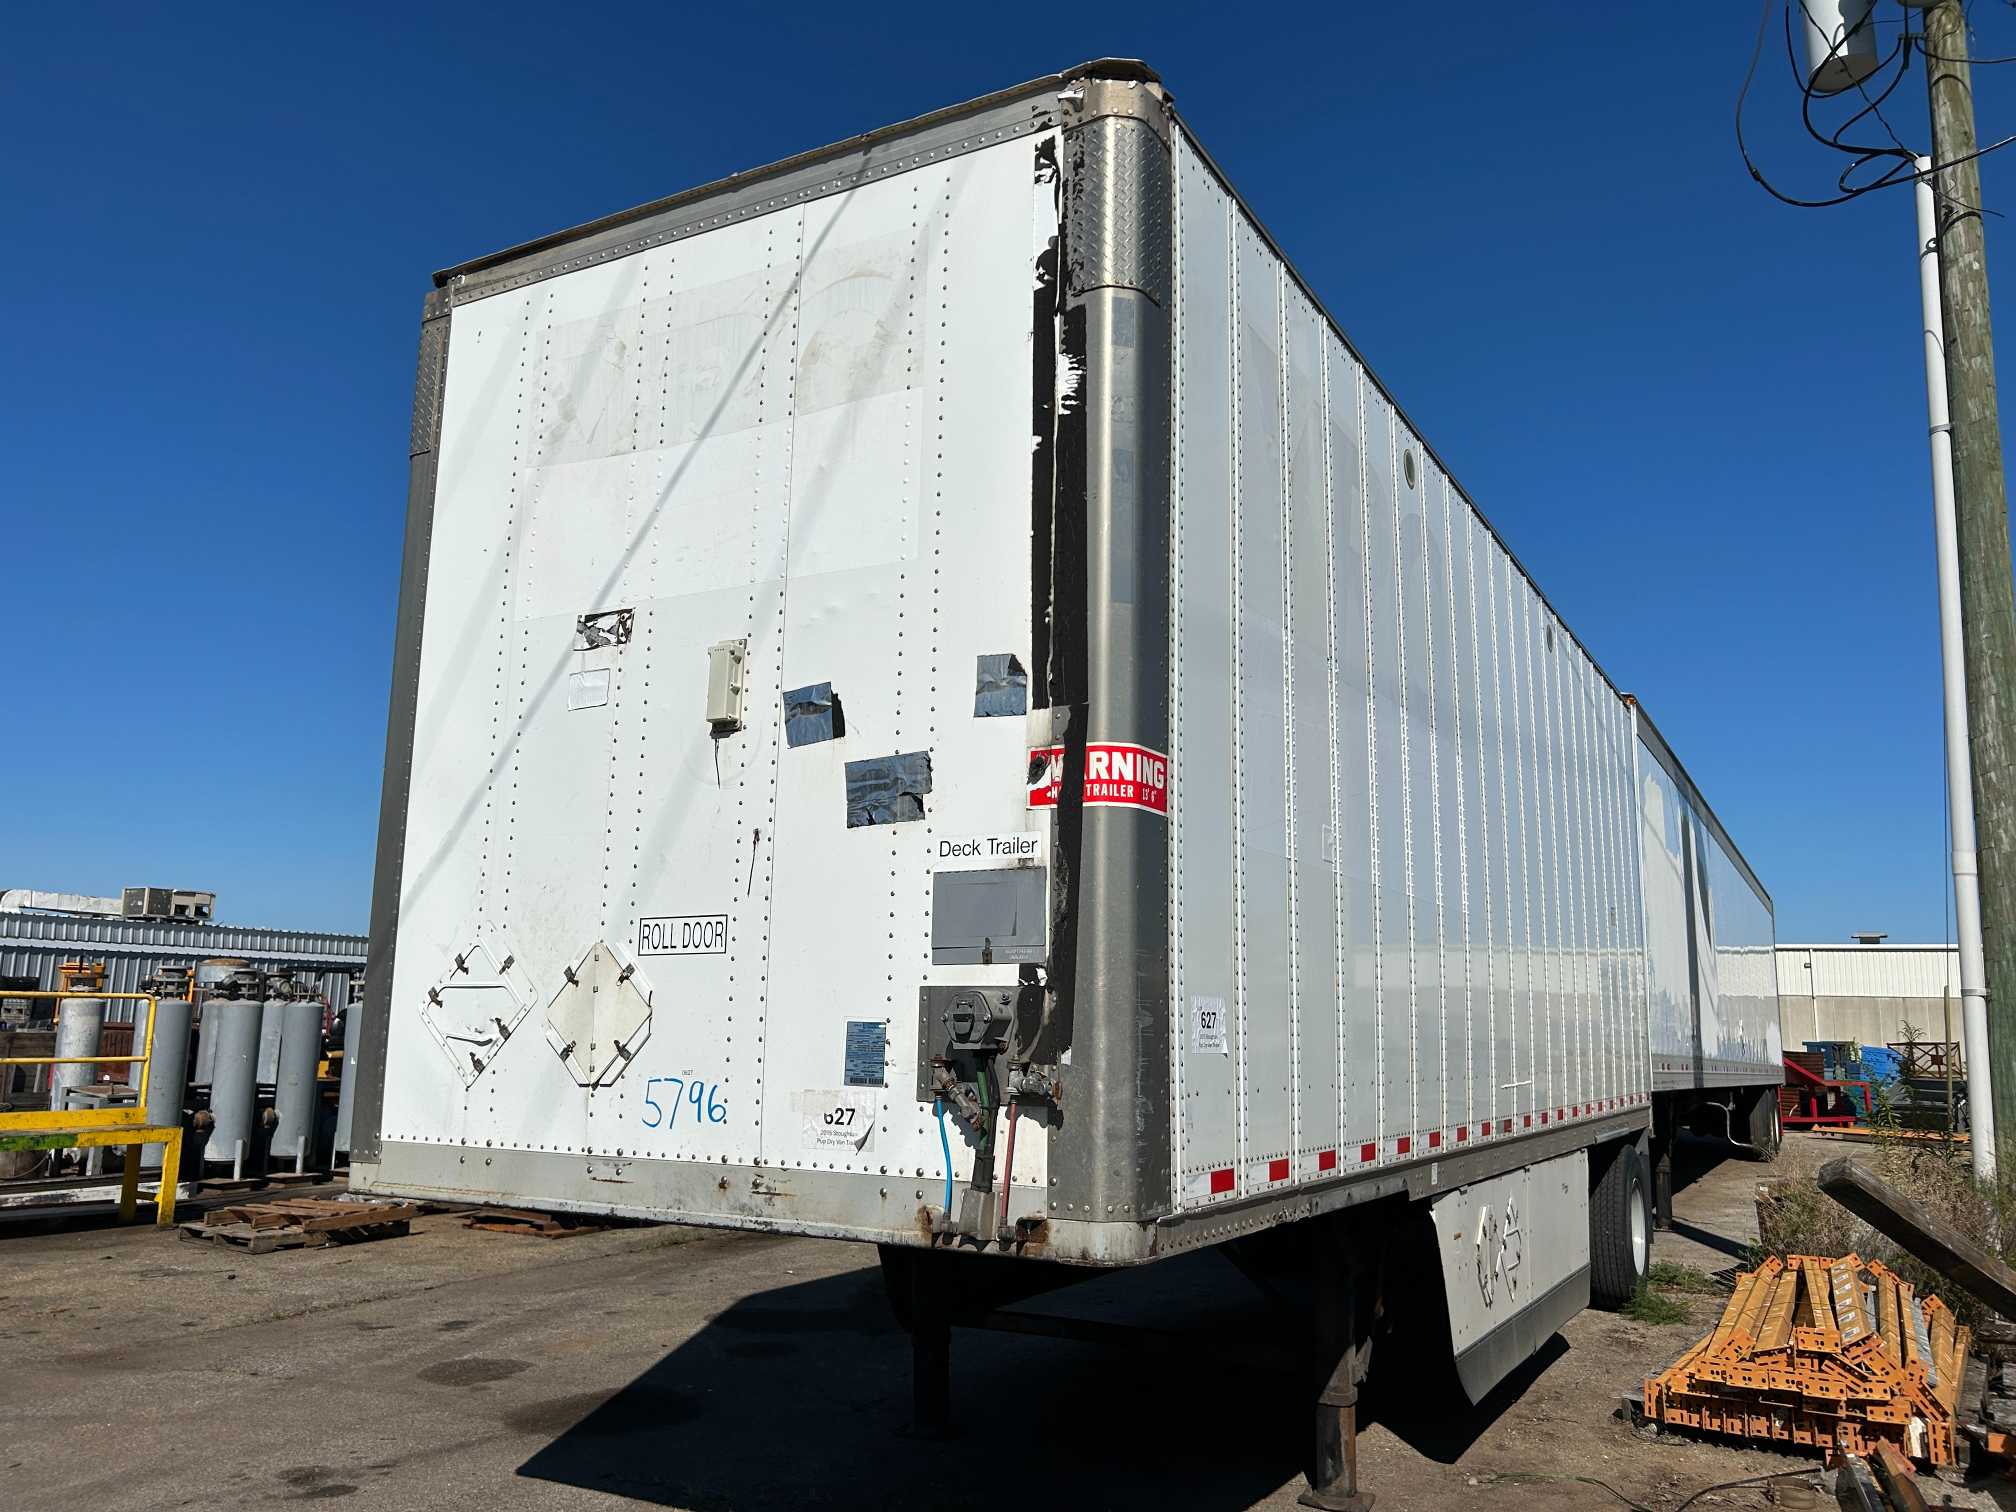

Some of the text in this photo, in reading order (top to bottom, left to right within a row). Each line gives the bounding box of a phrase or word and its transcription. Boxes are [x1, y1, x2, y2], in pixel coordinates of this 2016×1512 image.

[1050, 751, 1164, 789] WRNING
[1086, 783, 1134, 798] TRAILER
[939, 836, 1038, 857] Deck Trailer
[641, 921, 724, 950] ROLL DOOR
[1201, 1011, 1217, 1029] 627
[641, 1077, 726, 1130] 5796
